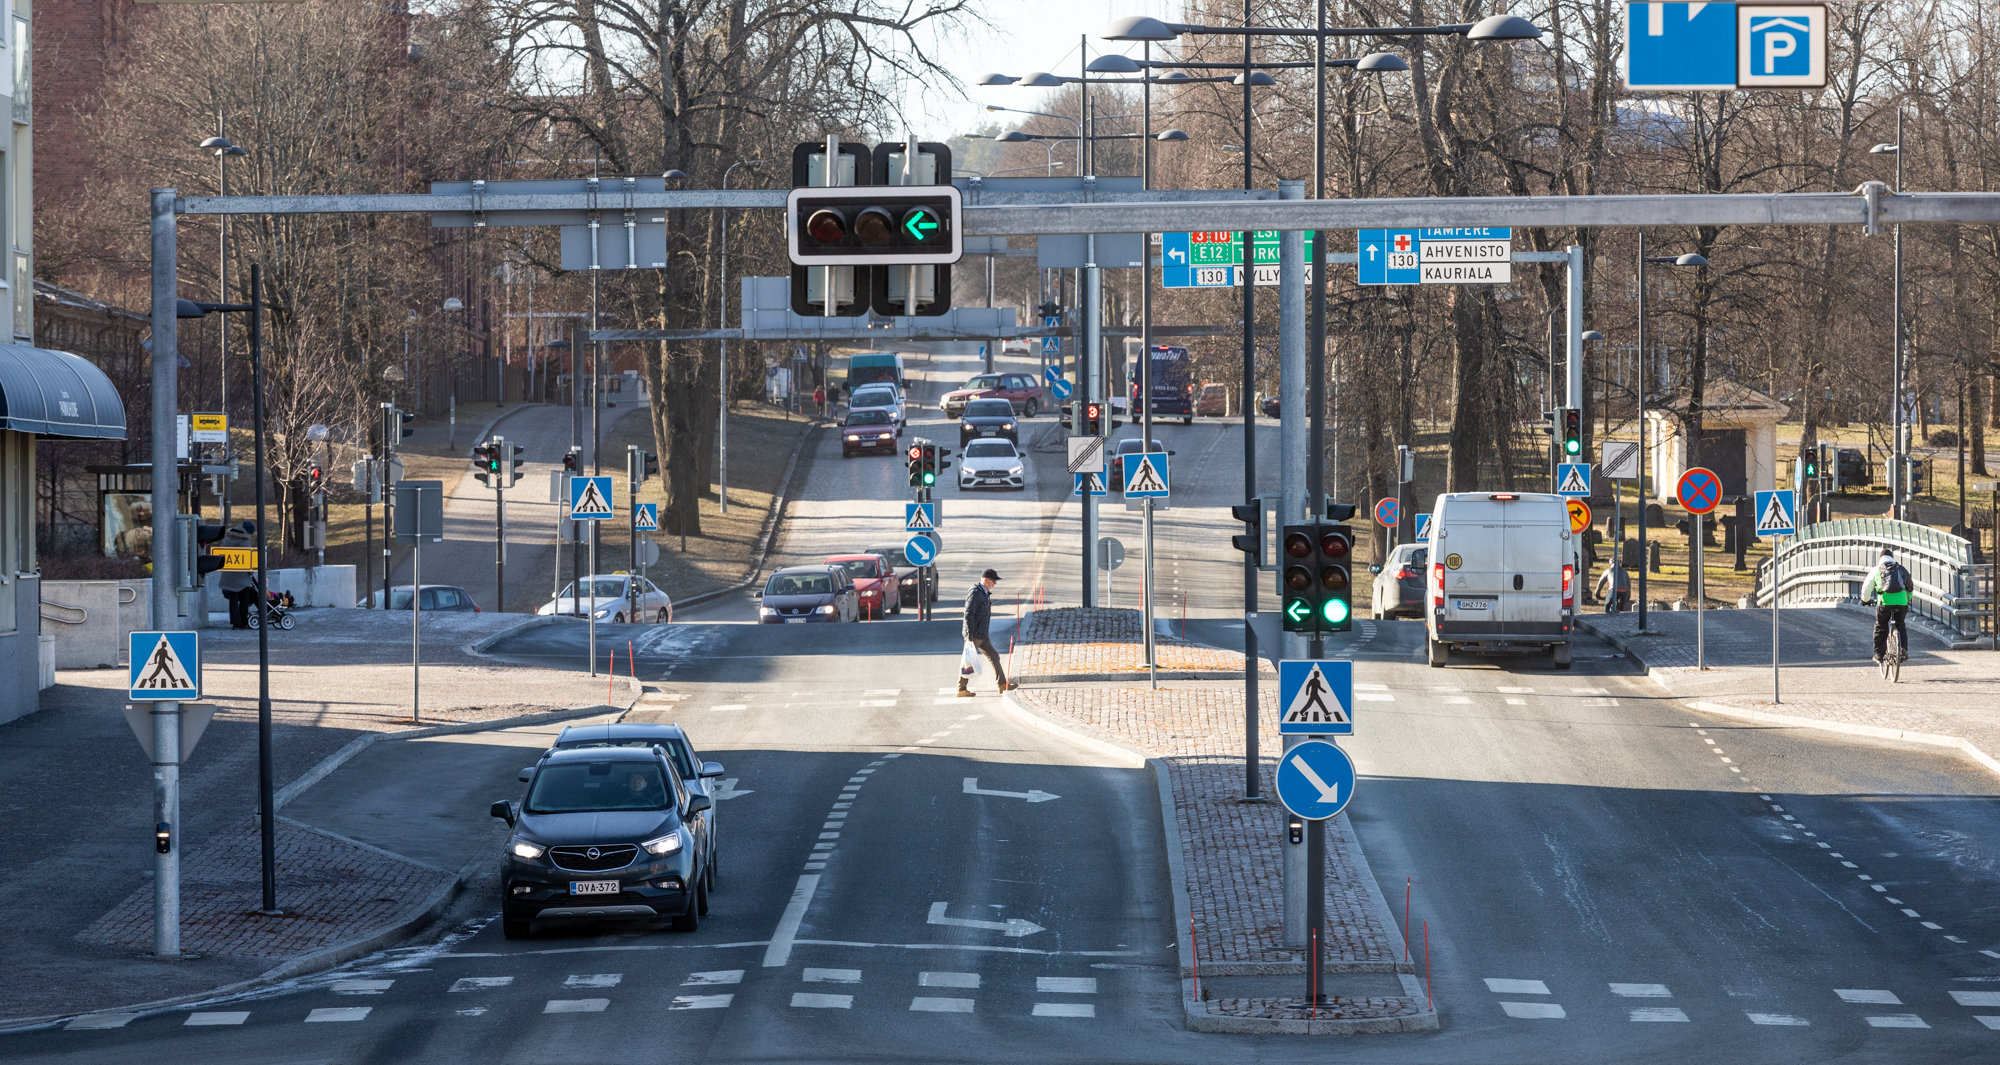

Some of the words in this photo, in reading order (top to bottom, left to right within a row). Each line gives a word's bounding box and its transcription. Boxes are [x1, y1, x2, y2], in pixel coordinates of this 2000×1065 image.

[1765, 32, 1797, 73] P
[1196, 231, 1204, 241] 3
[1200, 246, 1223, 259] E12
[1239, 247, 1280, 260] TRK
[1426, 245, 1504, 258] AHVENISTO
[1392, 255, 1414, 267] 130
[1201, 270, 1223, 283] 130
[1426, 267, 1493, 280] KAURIALA
[220, 554, 245, 565] AXI
[1449, 556, 1460, 567] 100
[578, 883, 617, 893] OVA-372
